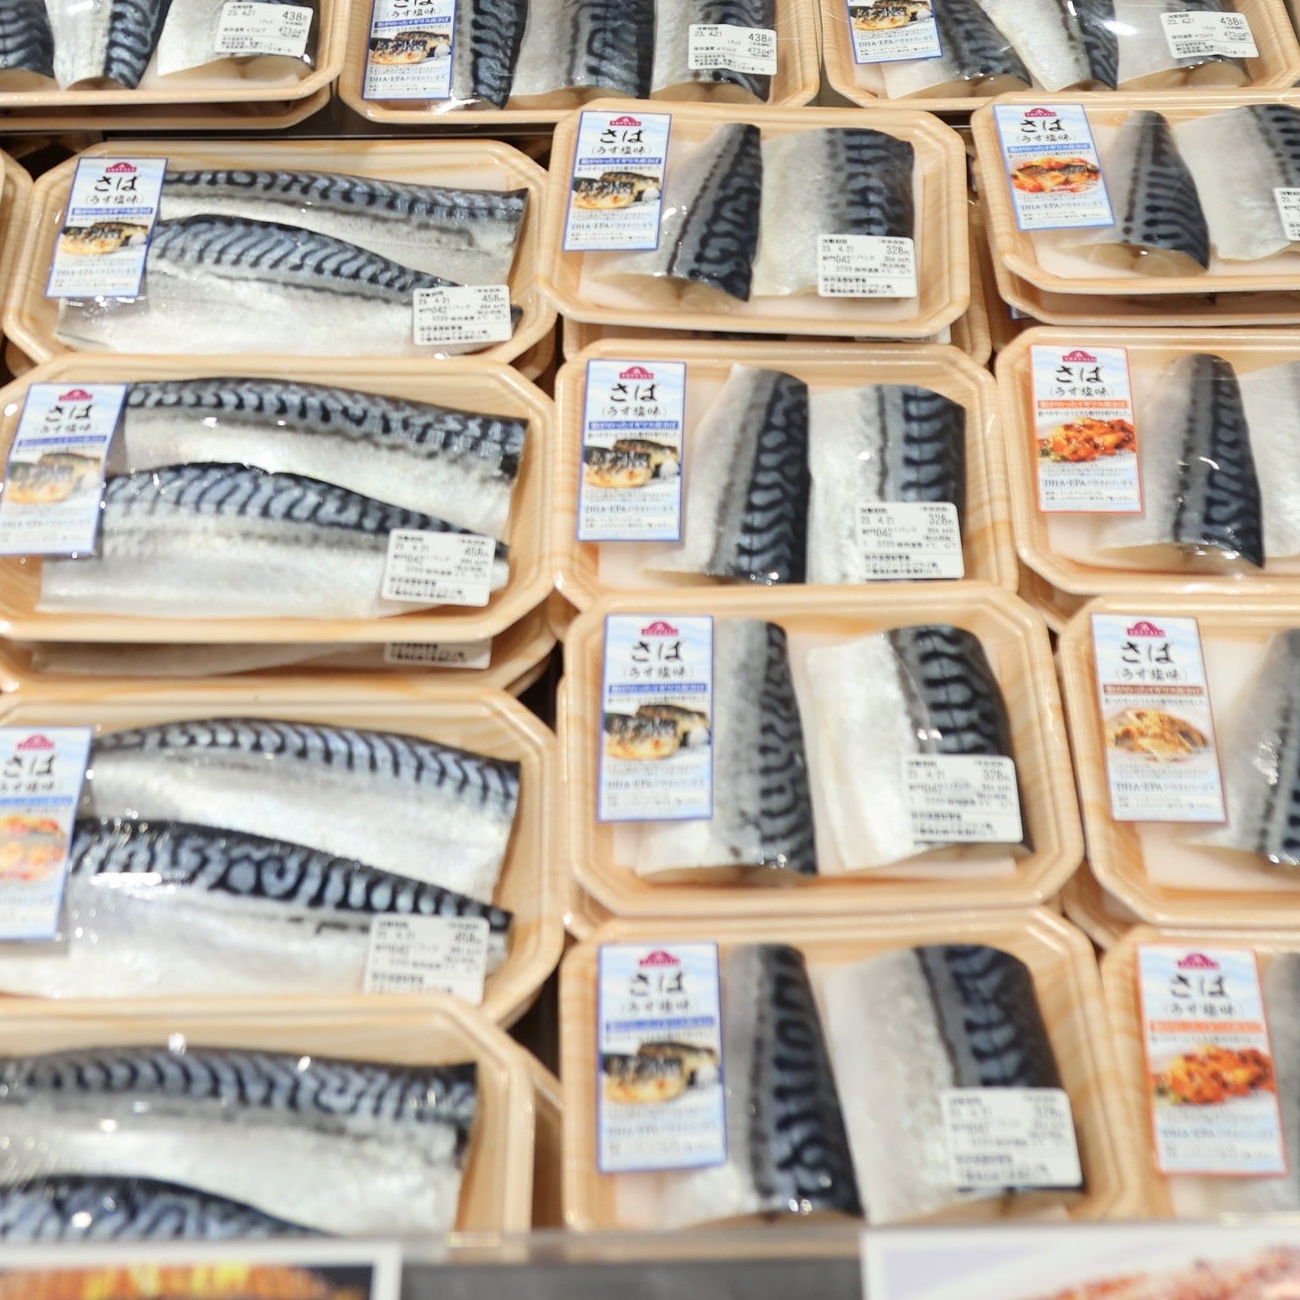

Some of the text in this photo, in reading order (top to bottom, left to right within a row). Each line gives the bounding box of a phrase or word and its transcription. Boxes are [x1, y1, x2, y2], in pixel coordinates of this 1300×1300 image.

[1020, 117, 1066, 133] さば
[600, 128, 647, 144] さば
[93, 174, 141, 192] さば
[1055, 365, 1104, 384] さば
[610, 382, 661, 403] さば
[45, 402, 99, 421] さば
[631, 639, 685, 662] さば
[1120, 641, 1175, 664] さば
[629, 971, 686, 997] さば
[1169, 975, 1229, 999] さば
